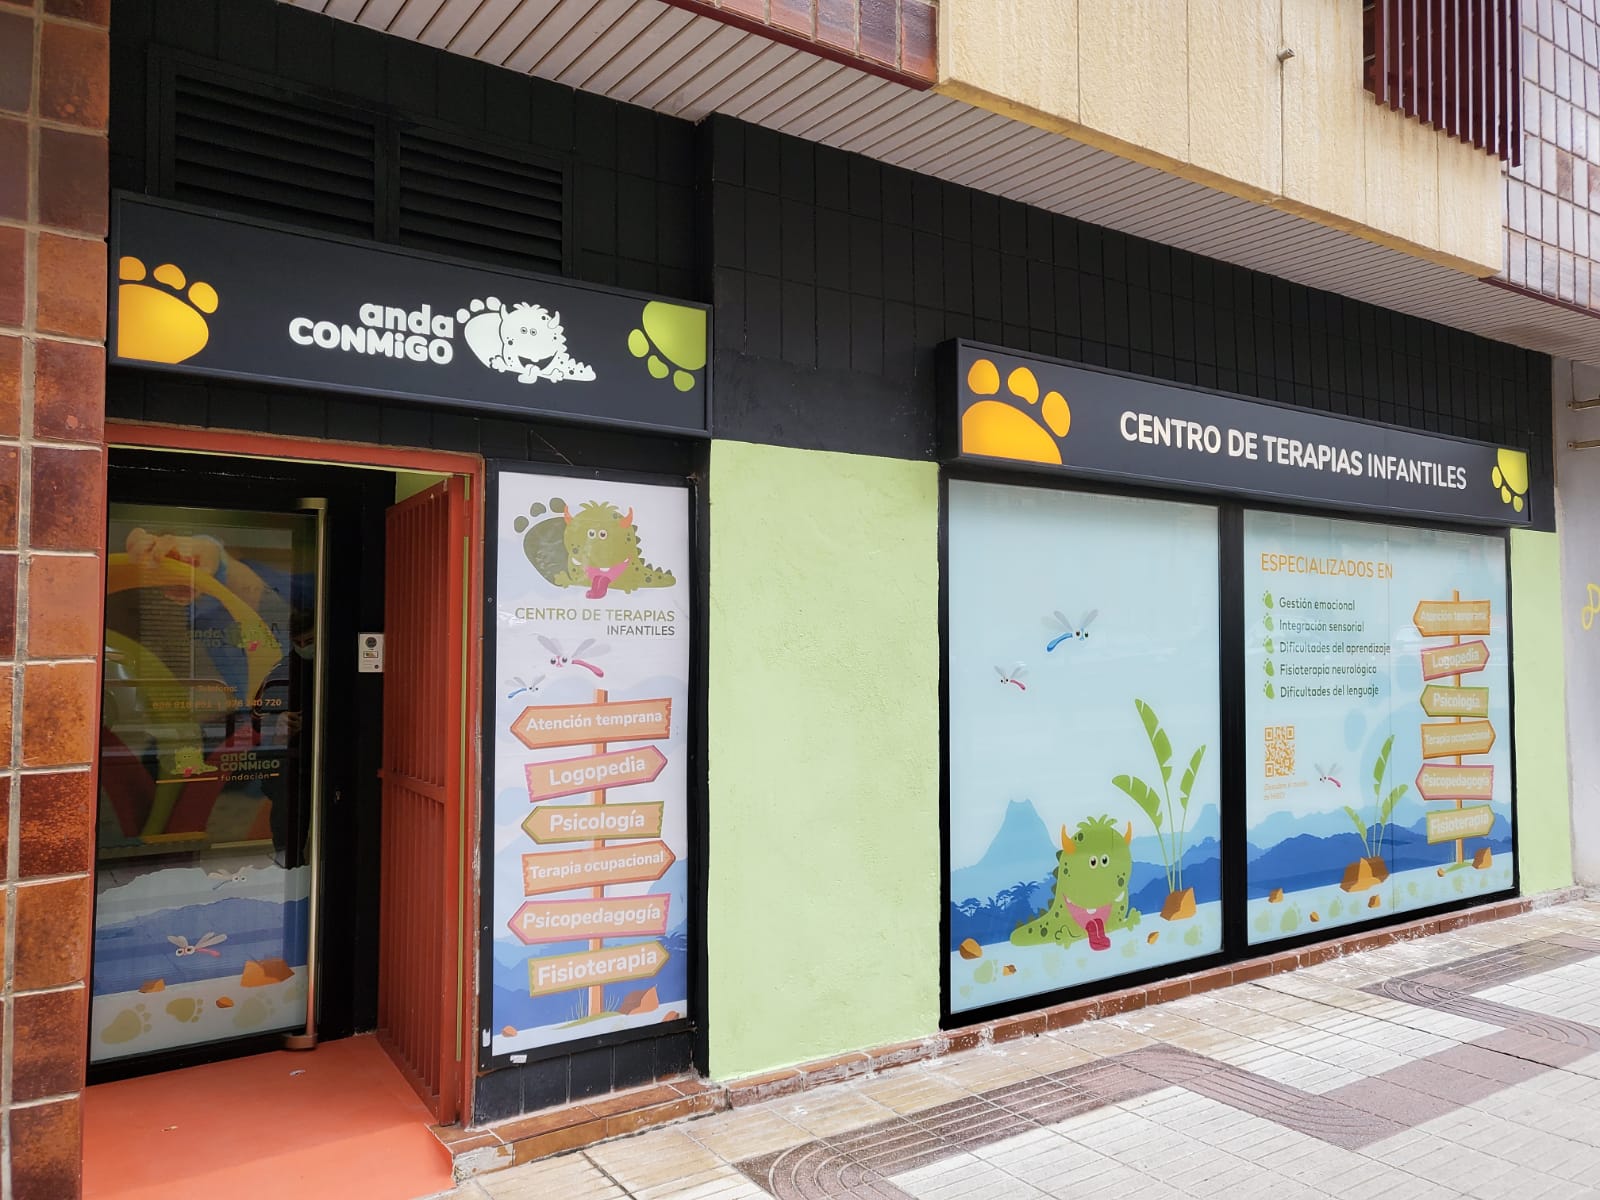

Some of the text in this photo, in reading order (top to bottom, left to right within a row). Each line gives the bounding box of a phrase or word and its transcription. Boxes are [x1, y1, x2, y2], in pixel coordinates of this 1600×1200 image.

[359, 303, 454, 338] anda
[1120, 411, 1467, 490] CENTRO DE TERAPIAS INFANTILES
[1261, 553, 1393, 579] ESPECIALIZADOS EN
[1279, 597, 1356, 611] Gestión emocional
[515, 607, 675, 622] CENTRO DE TERAPIAS
[607, 625, 675, 636] INFANTILES
[1279, 619, 1364, 633] Integración sensorial
[1279, 641, 1391, 655] Dificultades del aprendizaje
[1432, 648, 1480, 669] Logopedia
[1280, 663, 1377, 677] Fisioterapia neurológica
[1280, 683, 1379, 698] Dificultades del lenguaje
[526, 712, 662, 732] Atención temprana
[220, 750, 257, 762] anda
[221, 773, 270, 782] fundación
[549, 757, 646, 786] Logopedia
[550, 810, 645, 832] Psicología
[1431, 810, 1489, 834] Fisioterapia
[530, 851, 664, 879] Terapia ocupacional
[523, 904, 661, 928] Psicopedagogía
[538, 950, 657, 986] Fisioterapia
